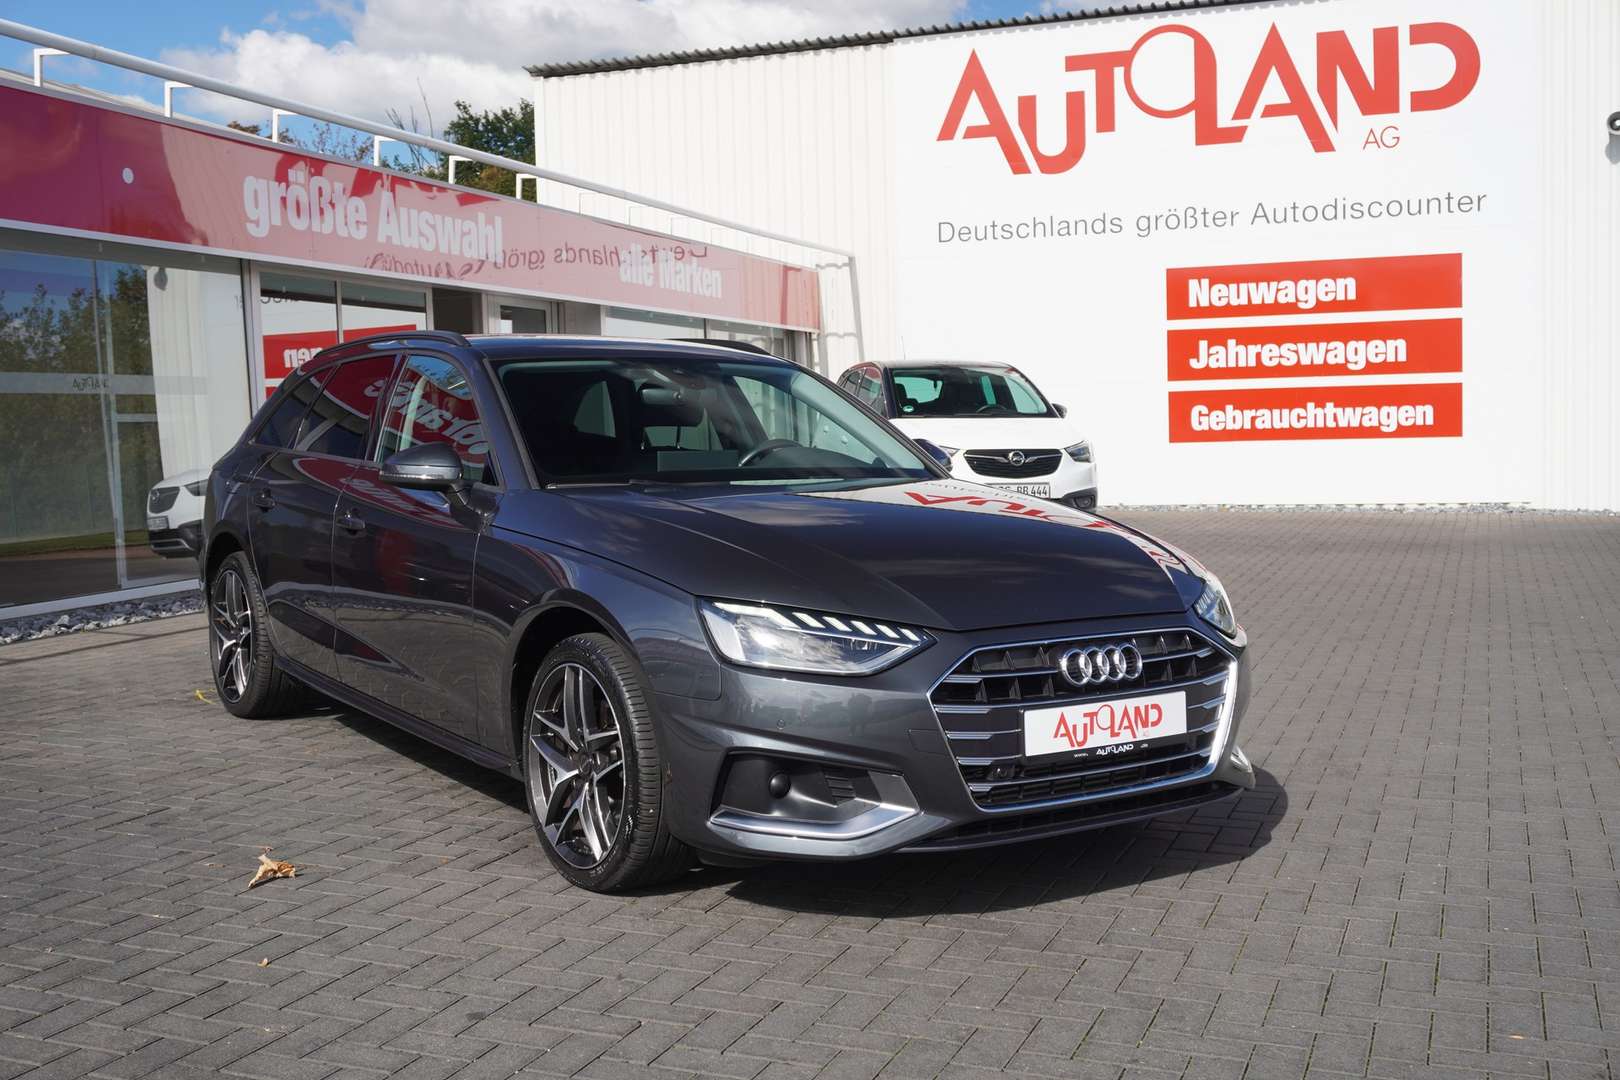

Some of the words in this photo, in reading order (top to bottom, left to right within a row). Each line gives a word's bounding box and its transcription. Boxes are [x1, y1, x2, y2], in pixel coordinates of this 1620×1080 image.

[936, 22, 1480, 175] AUTOLAND
[1362, 125, 1400, 150] AG
[243, 168, 368, 238] größte
[377, 191, 504, 264] Auswahl
[938, 212, 1123, 243] Deutschlands
[1136, 206, 1240, 238] größter
[1250, 192, 1487, 225] Autodiscounter
[619, 243, 654, 287] alle
[659, 251, 722, 299] Marken
[1188, 276, 1357, 309] Neuwagen
[1189, 338, 1408, 371] Jahreswagen
[1190, 402, 1435, 433] Gebrauchtwagen
[1031, 485, 1047, 497] 444
[1053, 703, 1163, 748] AUTOLAND
